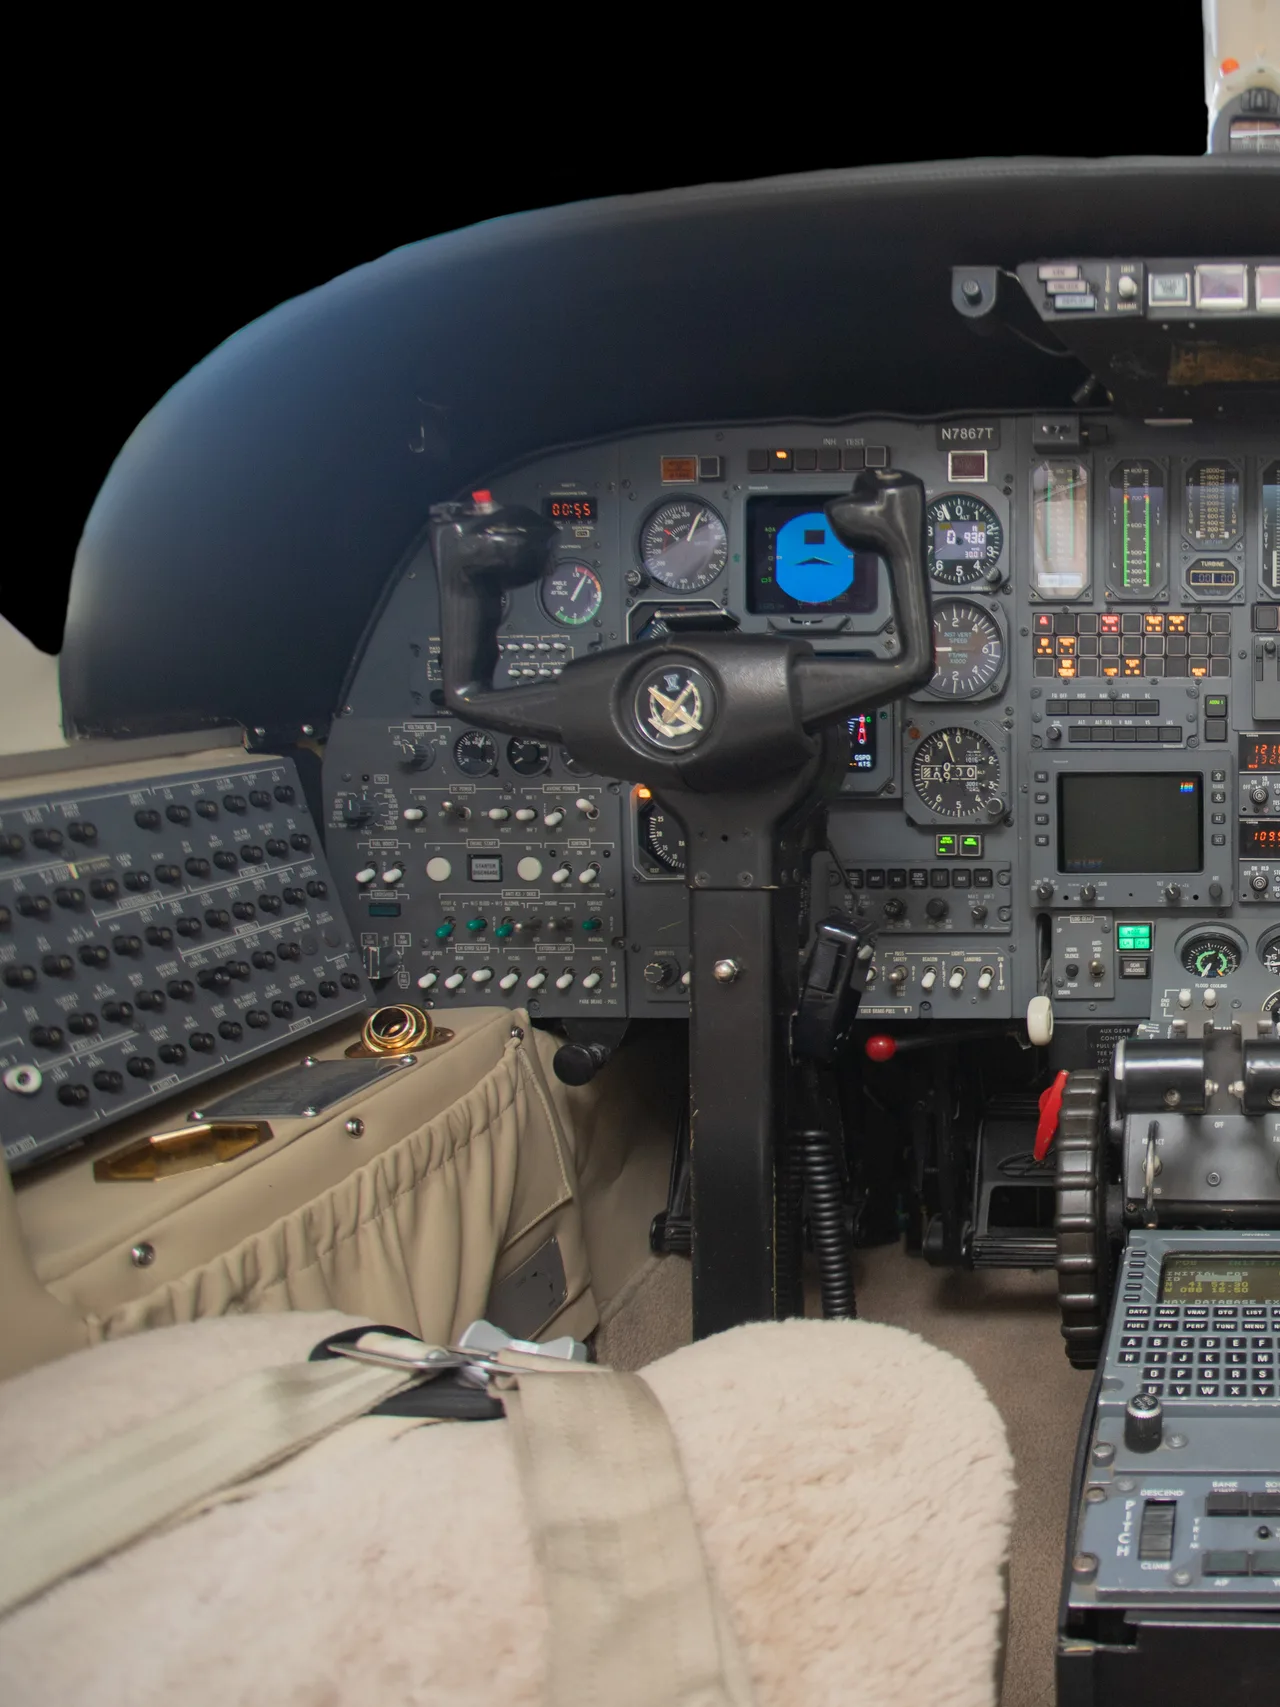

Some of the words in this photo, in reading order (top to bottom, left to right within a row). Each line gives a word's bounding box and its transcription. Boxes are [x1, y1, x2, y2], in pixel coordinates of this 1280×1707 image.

[942, 428, 993, 440] N7867T
[552, 503, 591, 517] 00:55
[956, 506, 963, 515] 0
[964, 532, 985, 544] 930
[956, 566, 963, 576] 5
[1212, 1481, 1238, 1489] BANK
[1116, 1500, 1136, 1557] PITCH
[1141, 1562, 1170, 1571] CLIMB
